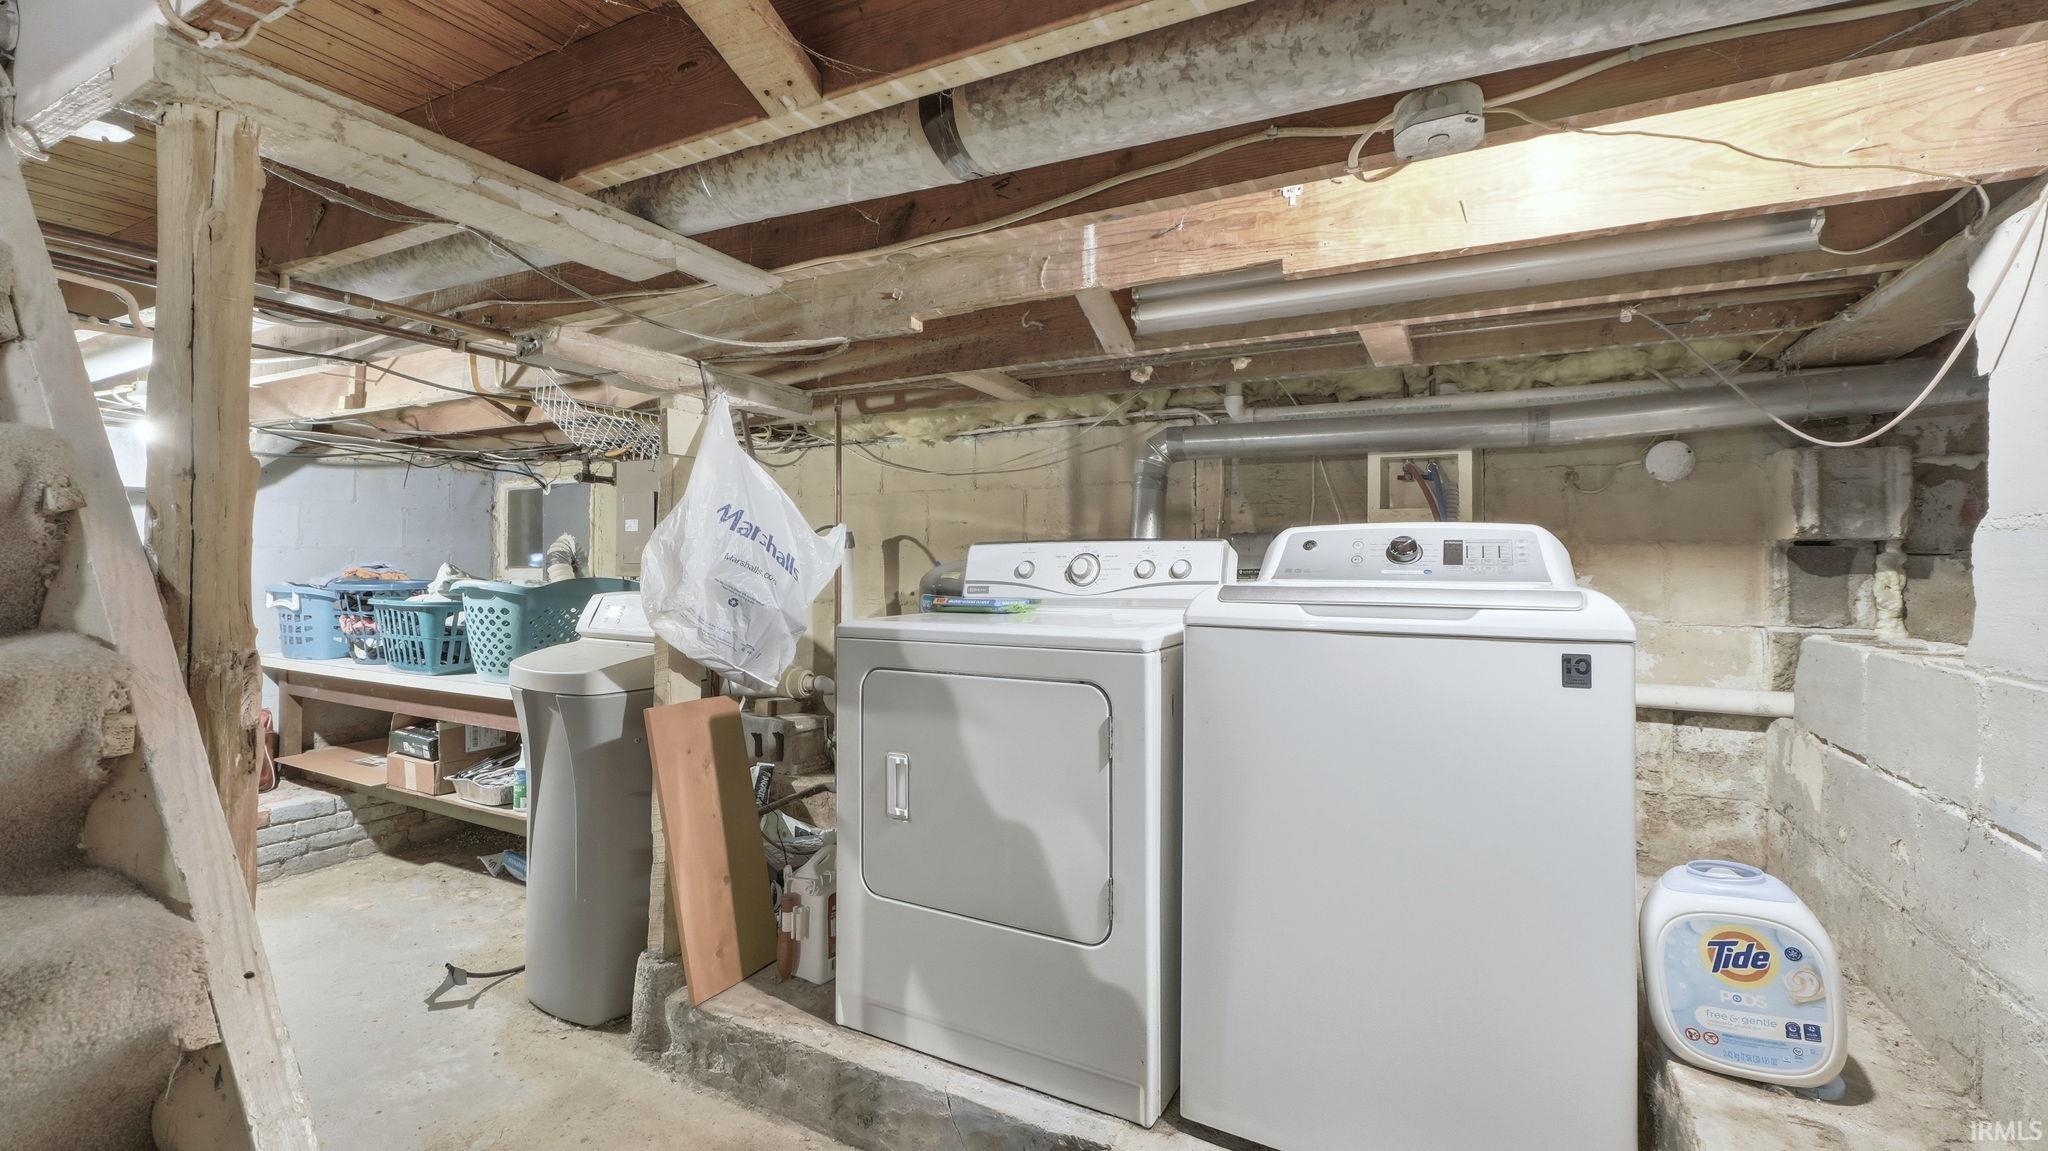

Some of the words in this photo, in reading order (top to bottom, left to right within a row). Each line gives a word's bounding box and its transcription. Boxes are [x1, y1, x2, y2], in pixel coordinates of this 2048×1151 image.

[716, 503, 800, 585] Marshalls
[1707, 940, 1771, 973] Tide
[1705, 1009, 1728, 1021] free
[1729, 1014, 1741, 1023] &
[1741, 1016, 1778, 1028] gentle
